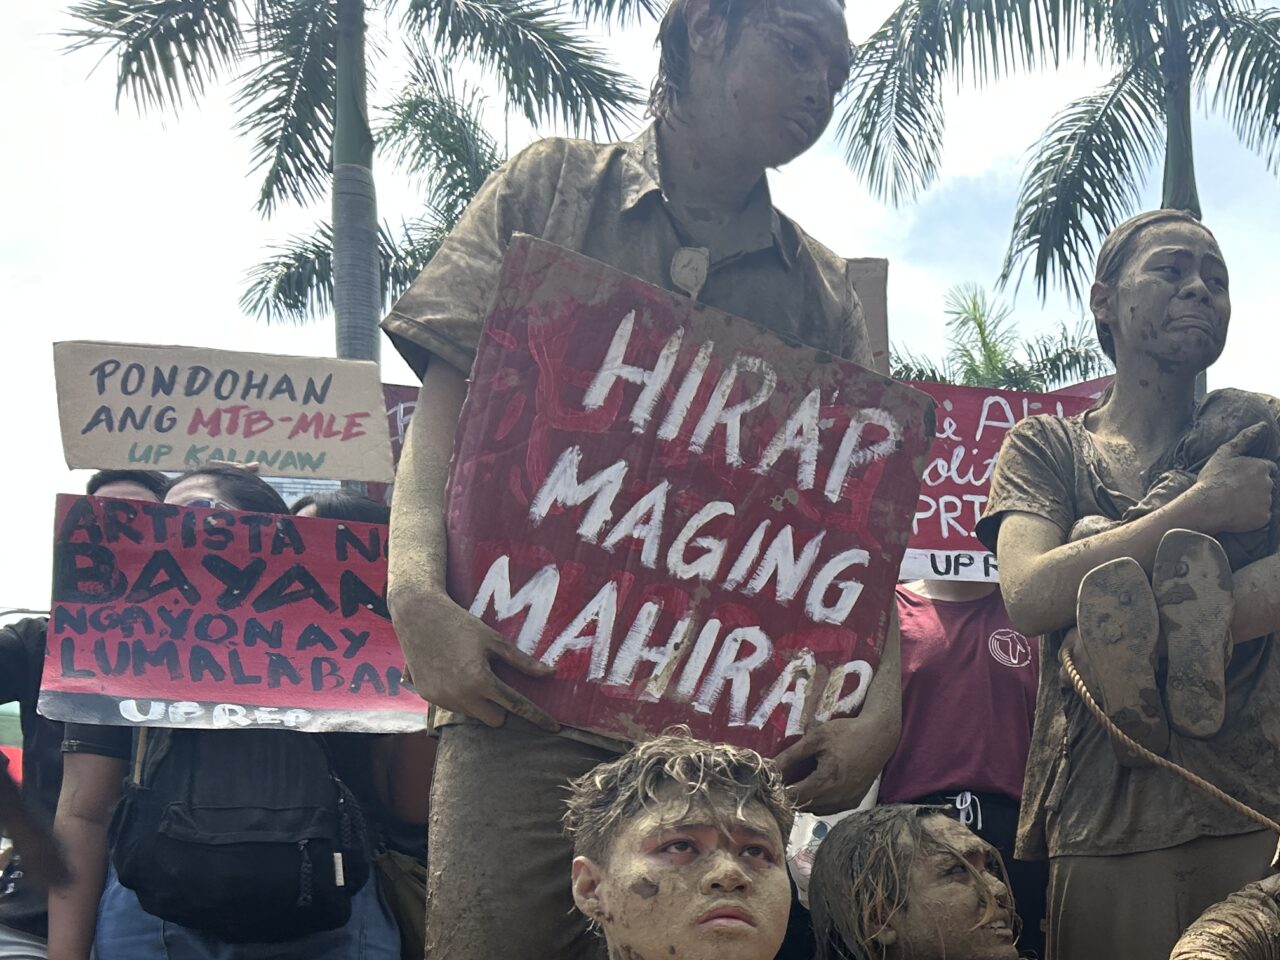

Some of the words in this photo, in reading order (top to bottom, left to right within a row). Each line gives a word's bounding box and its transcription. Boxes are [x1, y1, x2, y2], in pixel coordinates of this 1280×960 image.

[90, 359, 333, 405] PONDOHAN
[583, 310, 902, 503] HIRAP
[82, 405, 178, 435] ANG
[187, 404, 371, 441] MTB-MLE
[128, 442, 173, 465] UP
[60, 498, 306, 557] ARTISTA
[528, 445, 870, 626] MAGING
[930, 553, 975, 577] UP
[54, 604, 284, 649] NGAYON
[296, 623, 370, 659] AY
[468, 554, 874, 737] MAHIRAP
[118, 699, 203, 725] UP
